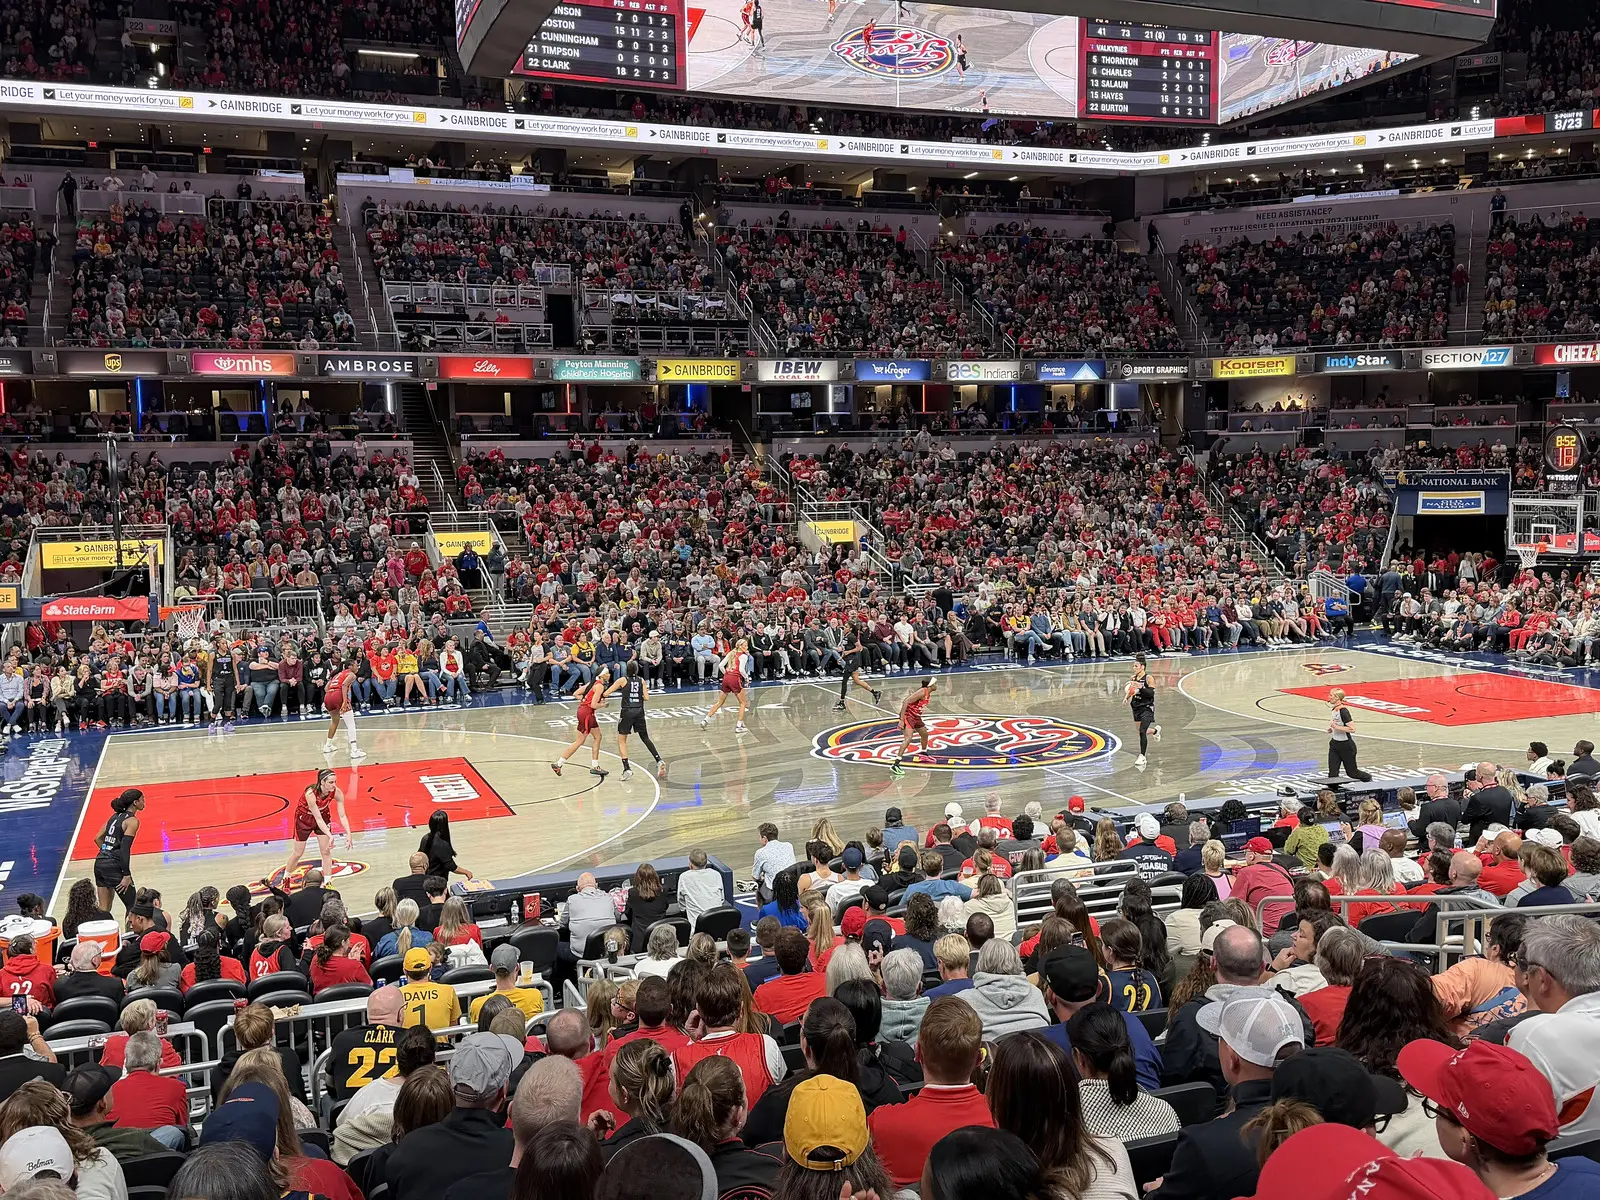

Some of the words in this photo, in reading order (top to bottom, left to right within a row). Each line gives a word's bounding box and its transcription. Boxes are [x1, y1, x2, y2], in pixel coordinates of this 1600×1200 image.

[616, 13, 623, 21] 7
[632, 15, 638, 23] 0
[649, 16, 653, 24] 1
[661, 18, 668, 26] 2
[130, 22, 143, 30] 223
[160, 24, 172, 33] 224
[614, 26, 625, 35] 15
[630, 28, 640, 36] 11
[648, 30, 654, 38] 2
[661, 31, 668, 39] 3
[1097, 28, 1106, 36] 41
[1120, 29, 1131, 37] 73
[1144, 31, 1153, 39] 21
[1177, 33, 1187, 41] 10
[1194, 34, 1204, 42] 12
[541, 32, 599, 46] CUNNINGHAM
[617, 40, 623, 48] 6
[632, 42, 639, 50] 0
[649, 43, 654, 52] 1
[661, 45, 668, 53] 3
[1096, 44, 1128, 53] VALKYRIES
[527, 44, 538, 53] 21
[541, 45, 580, 58] TIMPSON
[618, 54, 624, 62] 0
[634, 55, 639, 64] 5
[649, 57, 655, 65] 0
[663, 58, 669, 66] 0
[1101, 56, 1139, 66] THORNTON
[528, 58, 540, 67] 22
[542, 59, 571, 70] CLARK
[616, 67, 627, 76] 18
[634, 68, 640, 77] 2
[649, 70, 655, 79] 7
[663, 71, 669, 80] 3
[1101, 68, 1132, 77] CHARLES
[1175, 72, 1180, 80] 4
[1090, 79, 1099, 87] 13
[1162, 83, 1168, 91] 2
[60, 91, 73, 99] Let
[75, 92, 93, 101] your
[95, 94, 123, 103] money
[125, 95, 145, 103] work
[146, 96, 157, 104] for
[159, 98, 176, 107] you.
[1090, 91, 1099, 99] 15
[1101, 92, 1124, 100] HAYES
[1161, 95, 1169, 103] 15
[220, 100, 282, 113] GAINBRIDGE
[1100, 104, 1129, 113] BURTON
[306, 106, 319, 114] Let
[320, 107, 336, 116] your
[337, 109, 363, 118] money
[364, 110, 382, 118] work
[395, 112, 410, 121] you.
[451, 115, 507, 128] GAINBRIDGE
[1555, 117, 1582, 130] 8/23
[540, 123, 555, 131] your
[557, 124, 580, 134] money
[609, 128, 623, 136] you.
[660, 129, 710, 142] GAINBRIDGE
[1388, 128, 1444, 142] GAINBRIDGE
[1464, 125, 1477, 133] Let
[1478, 125, 1493, 134] your
[740, 137, 754, 145] your
[755, 138, 774, 146] money
[848, 142, 894, 153] GAINBRIDGE
[1190, 148, 1240, 160] GAINBRIDGE
[1270, 145, 1285, 153] your
[1021, 152, 1064, 162] GAINBRIDGE
[1256, 211, 1277, 220] NEED
[1278, 207, 1333, 219] ASSISTANCE?
[105, 358, 121, 370] ups
[236, 356, 272, 372] mhs
[1424, 352, 1482, 364] SECTION
[1485, 351, 1504, 362] 127
[324, 359, 413, 372] AMBROSE
[473, 360, 501, 376] Lilly
[565, 360, 593, 370] Peyton
[594, 360, 629, 370] Manning
[675, 364, 736, 376] GAINBRIDGE
[774, 361, 822, 374] IBEW
[885, 362, 911, 379] Kroger
[949, 363, 980, 379] aes
[983, 368, 1019, 379] Indiana
[1041, 364, 1066, 374] Elevance
[1133, 366, 1155, 374] SPORT
[1156, 366, 1188, 374] GRAPHICS
[1220, 359, 1285, 370] Koorsen
[561, 369, 598, 379] Children's
[600, 369, 634, 379] Hospital
[1556, 436, 1576, 447] 8:52
[1559, 447, 1574, 466] 18
[1421, 478, 1469, 486] NATIONAL
[1471, 478, 1498, 486] BANK
[76, 555, 90, 564] your
[0, 594, 11, 603] GE
[631, 682, 639, 692] 13
[109, 820, 117, 835] 6
[256, 961, 270, 976] 22
[10, 981, 34, 998] 22
[404, 990, 438, 1001] DAVIS
[412, 1004, 426, 1025] 1
[364, 1030, 395, 1043] CLARK
[346, 1047, 400, 1089] 22
[27, 1158, 54, 1172] Belmar
